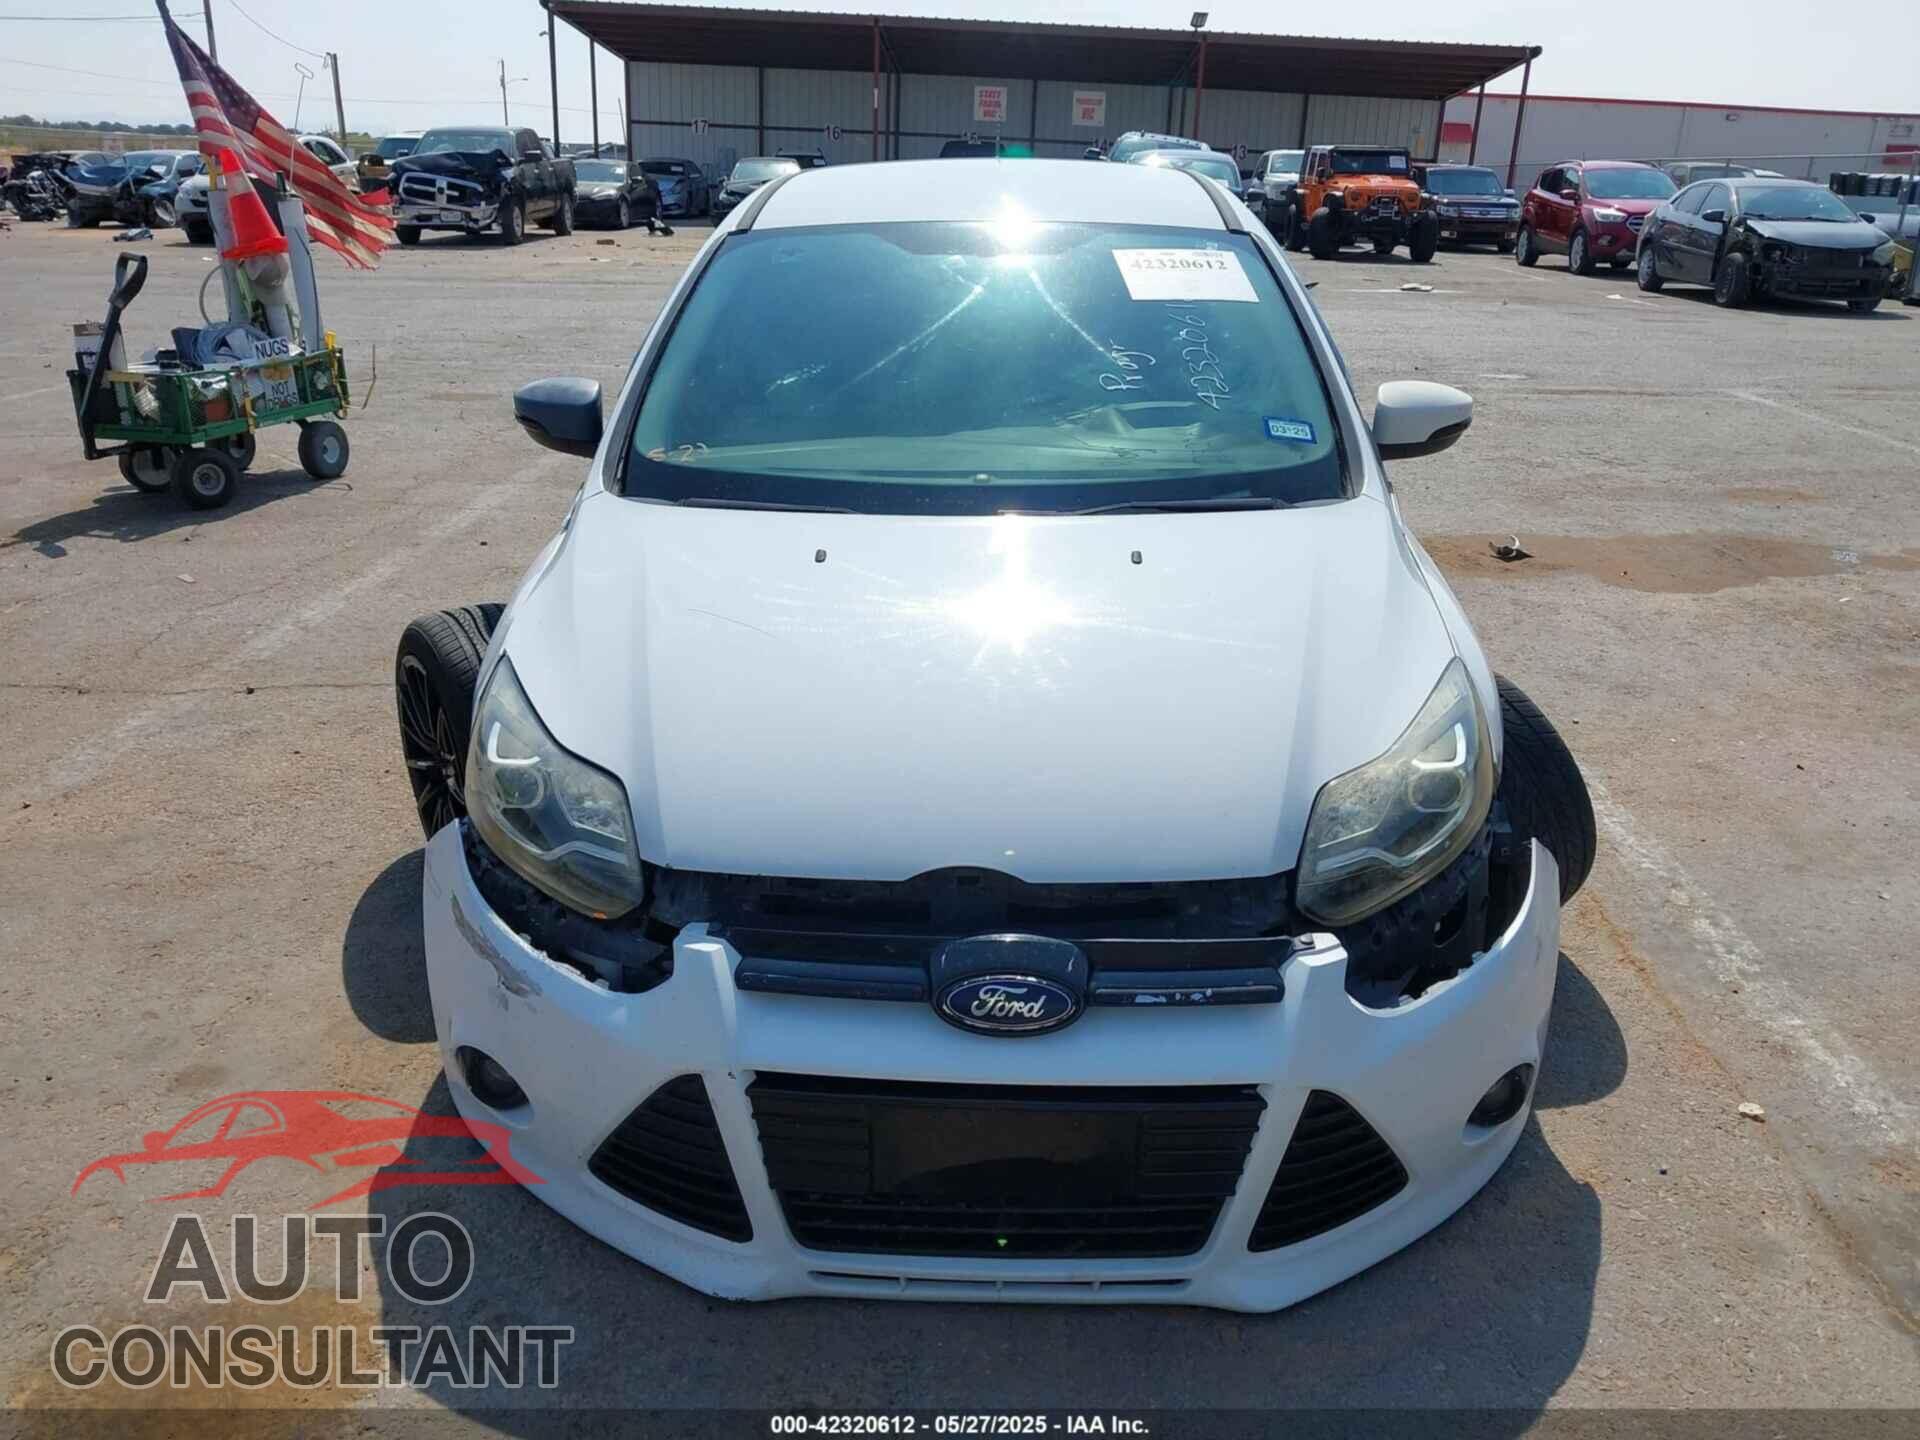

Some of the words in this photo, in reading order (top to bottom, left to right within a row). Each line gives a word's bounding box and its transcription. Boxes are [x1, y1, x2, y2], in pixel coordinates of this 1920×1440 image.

[693, 119, 708, 133] 17
[825, 124, 841, 140] 16
[1232, 144, 1247, 160] 13
[1130, 258, 1229, 271] 42320612
[254, 338, 290, 360] NUGS
[271, 382, 290, 397] NOT
[970, 984, 1047, 1018] Ford
